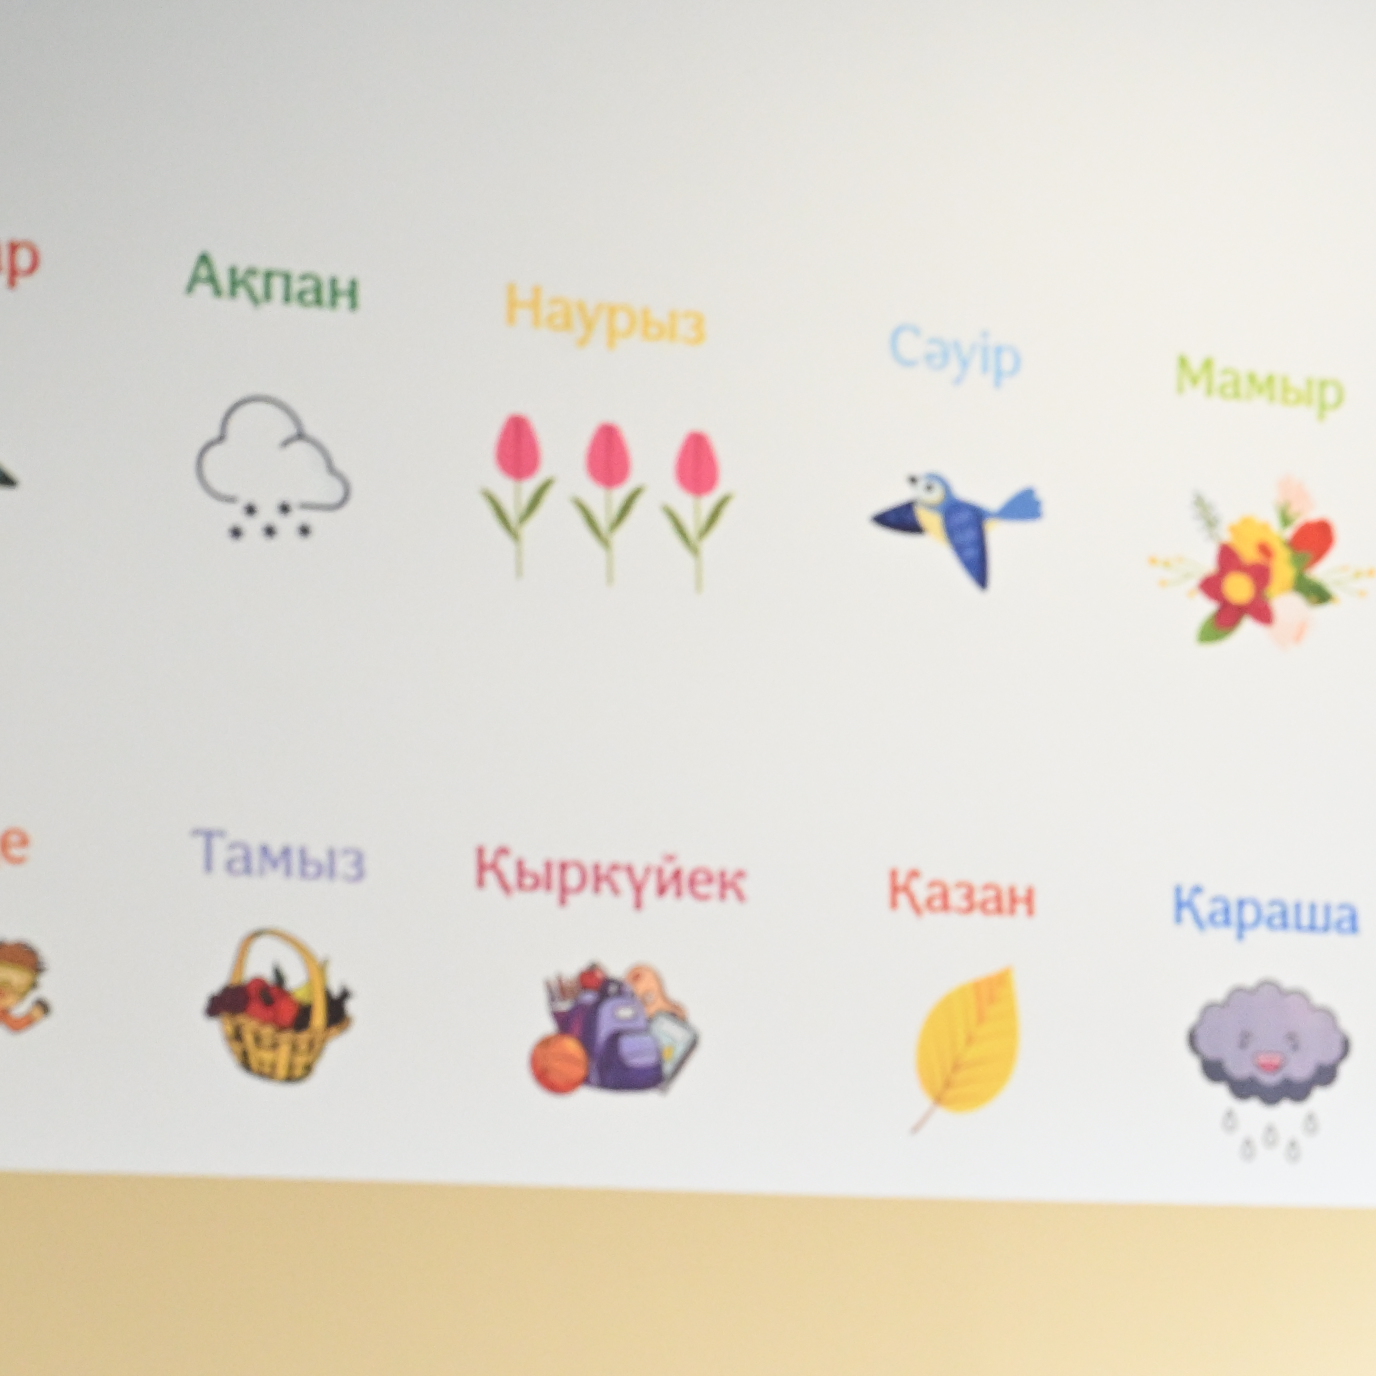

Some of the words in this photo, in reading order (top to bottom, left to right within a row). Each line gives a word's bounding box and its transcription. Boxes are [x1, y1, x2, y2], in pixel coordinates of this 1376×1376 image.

[184, 250, 360, 312] Ақпан
[504, 281, 708, 351] Наурыз
[888, 322, 1023, 390] Сәуір
[1176, 353, 1346, 422] Мамыр
[190, 827, 366, 884] Тамыз
[475, 844, 747, 912] Қыркүйек
[888, 867, 1037, 918] Қазан
[1173, 884, 1361, 942] Қараша
